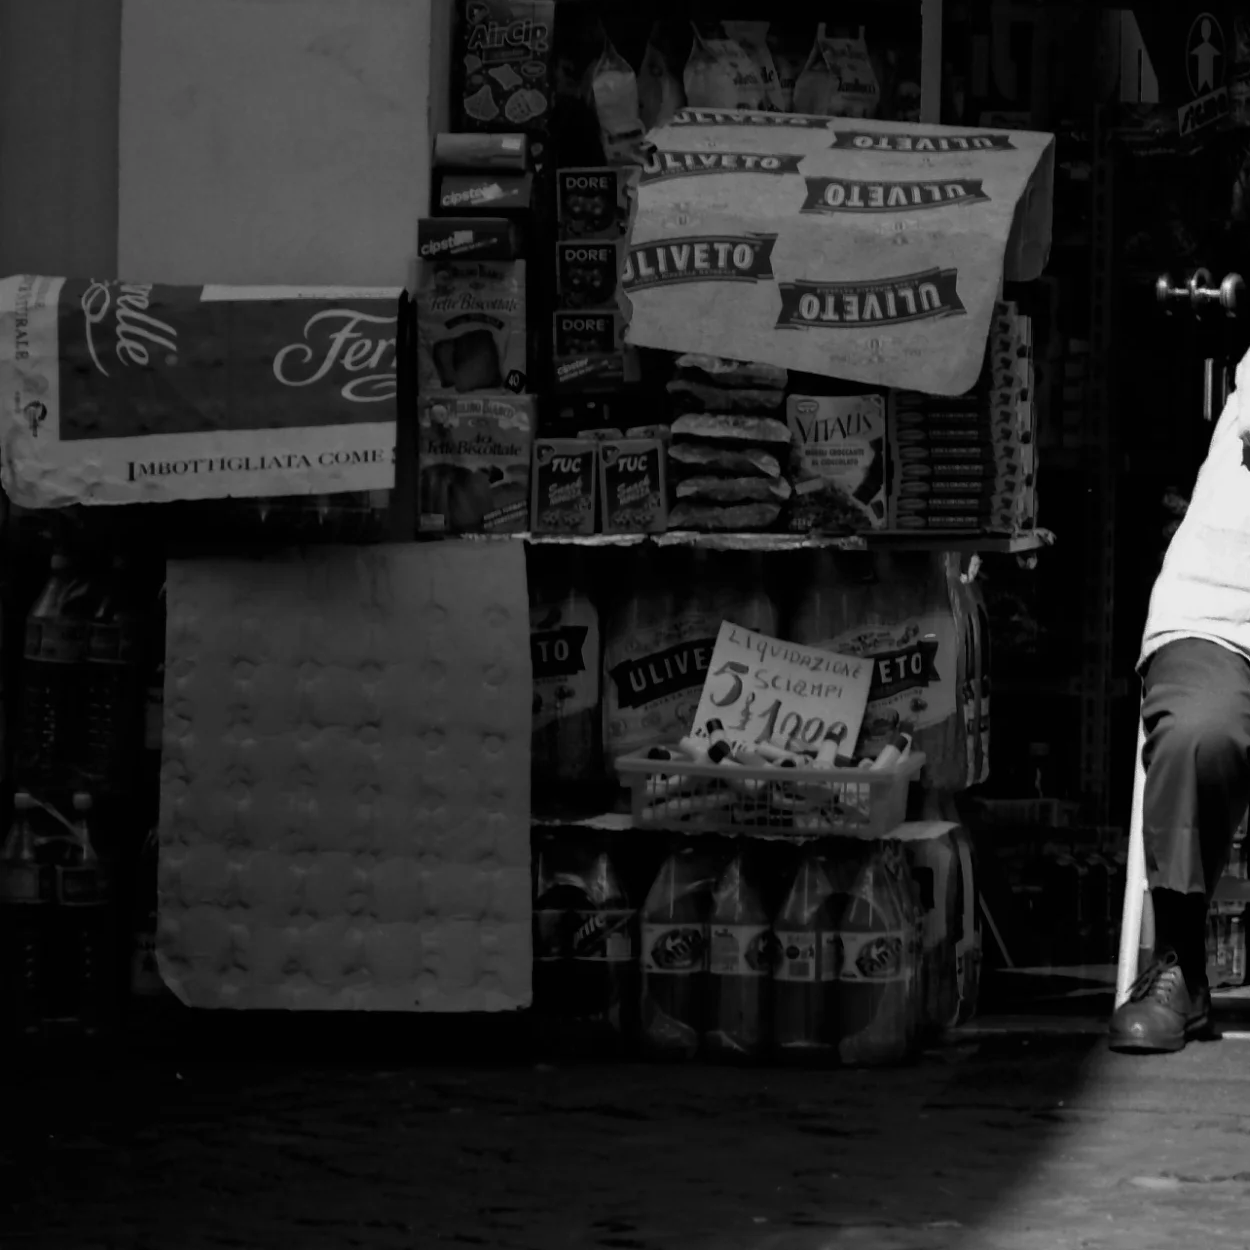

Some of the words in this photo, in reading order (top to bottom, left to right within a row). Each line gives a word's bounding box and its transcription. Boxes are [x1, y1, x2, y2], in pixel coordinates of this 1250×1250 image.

[853, 135, 994, 150] ULIVETO
[824, 182, 967, 208] ULIVETO
[799, 281, 943, 322] ULIVETO
[127, 454, 312, 481] IMBOTTIGLIATA
[318, 449, 385, 465] COME
[551, 457, 582, 473] TUC
[618, 456, 649, 473] TUC
[629, 645, 716, 693] ULIVE
[710, 661, 751, 707] 5
[879, 652, 923, 685] ETO
